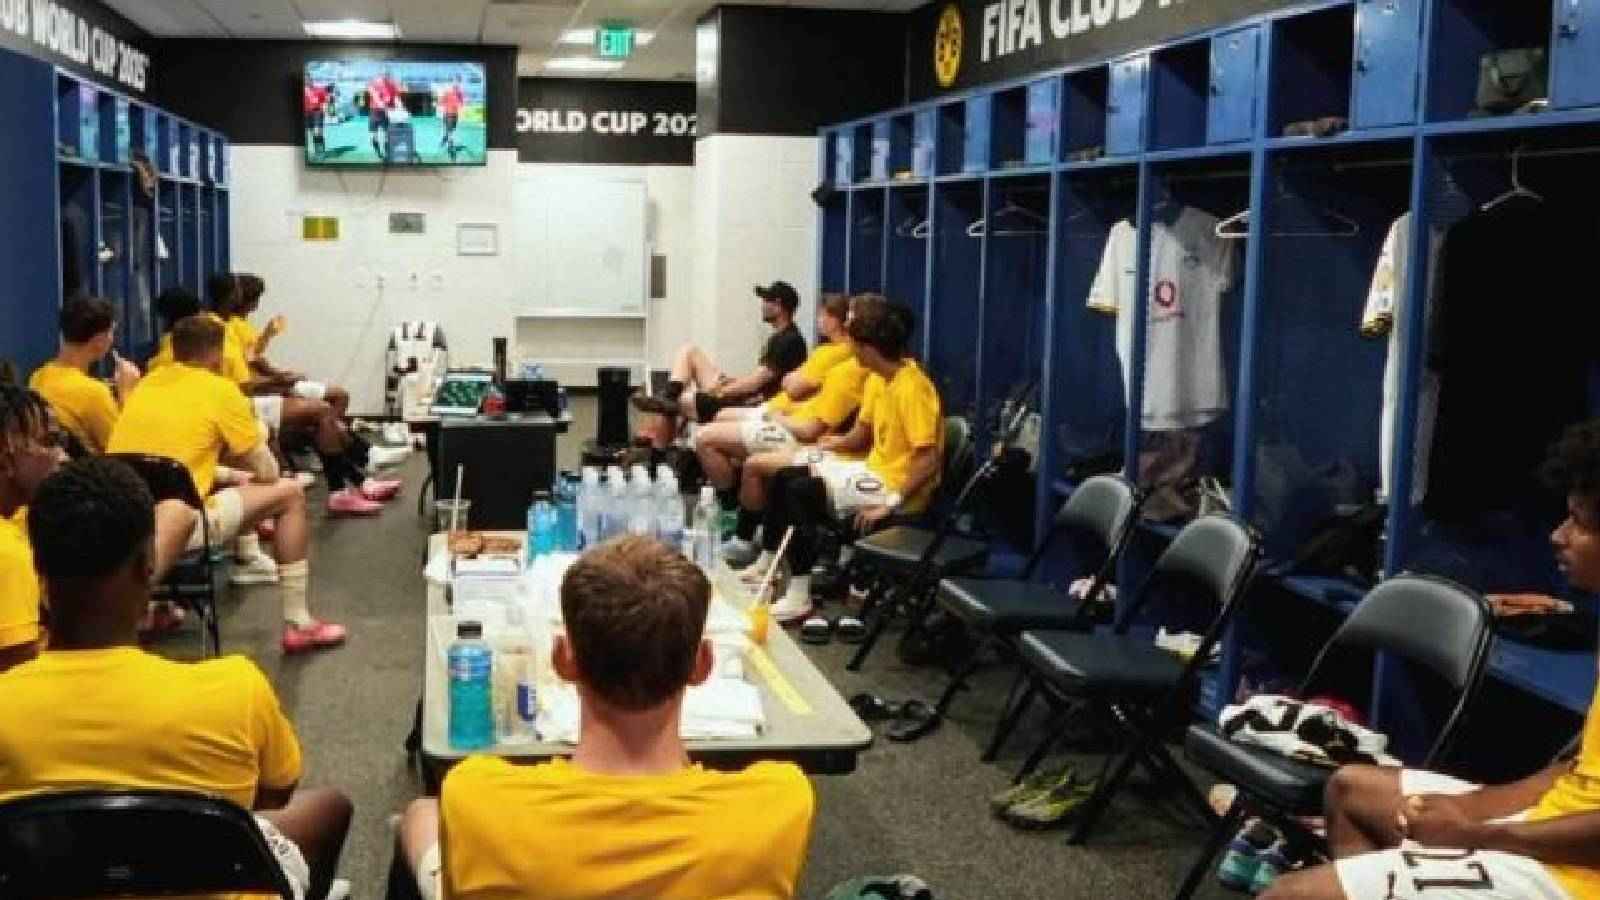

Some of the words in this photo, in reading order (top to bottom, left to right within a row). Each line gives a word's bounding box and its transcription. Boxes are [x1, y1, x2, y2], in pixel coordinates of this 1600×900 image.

[33, 0, 88, 63] WORLD
[93, 27, 116, 73] CUP
[600, 31, 632, 56] EXIT
[981, 0, 1042, 62] FIFA
[1051, 0, 1142, 38] CL
[592, 110, 648, 134] CUP
